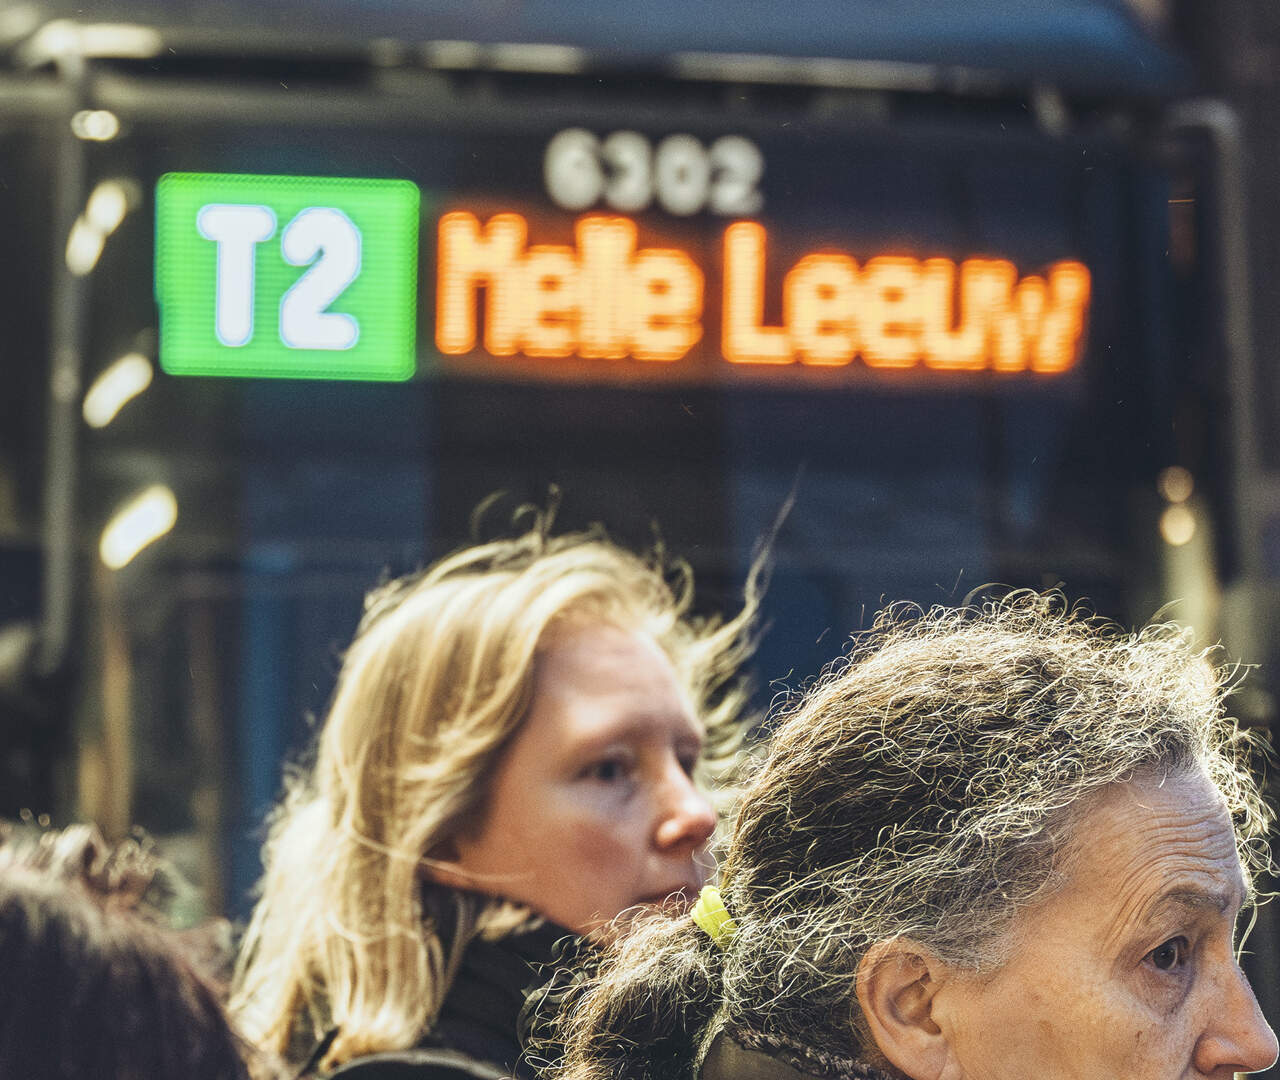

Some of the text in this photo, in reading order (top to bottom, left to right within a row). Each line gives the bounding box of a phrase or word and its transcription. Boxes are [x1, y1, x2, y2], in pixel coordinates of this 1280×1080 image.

[545, 129, 763, 215] 6302
[196, 203, 1091, 373] T2 Melle Leeuw
